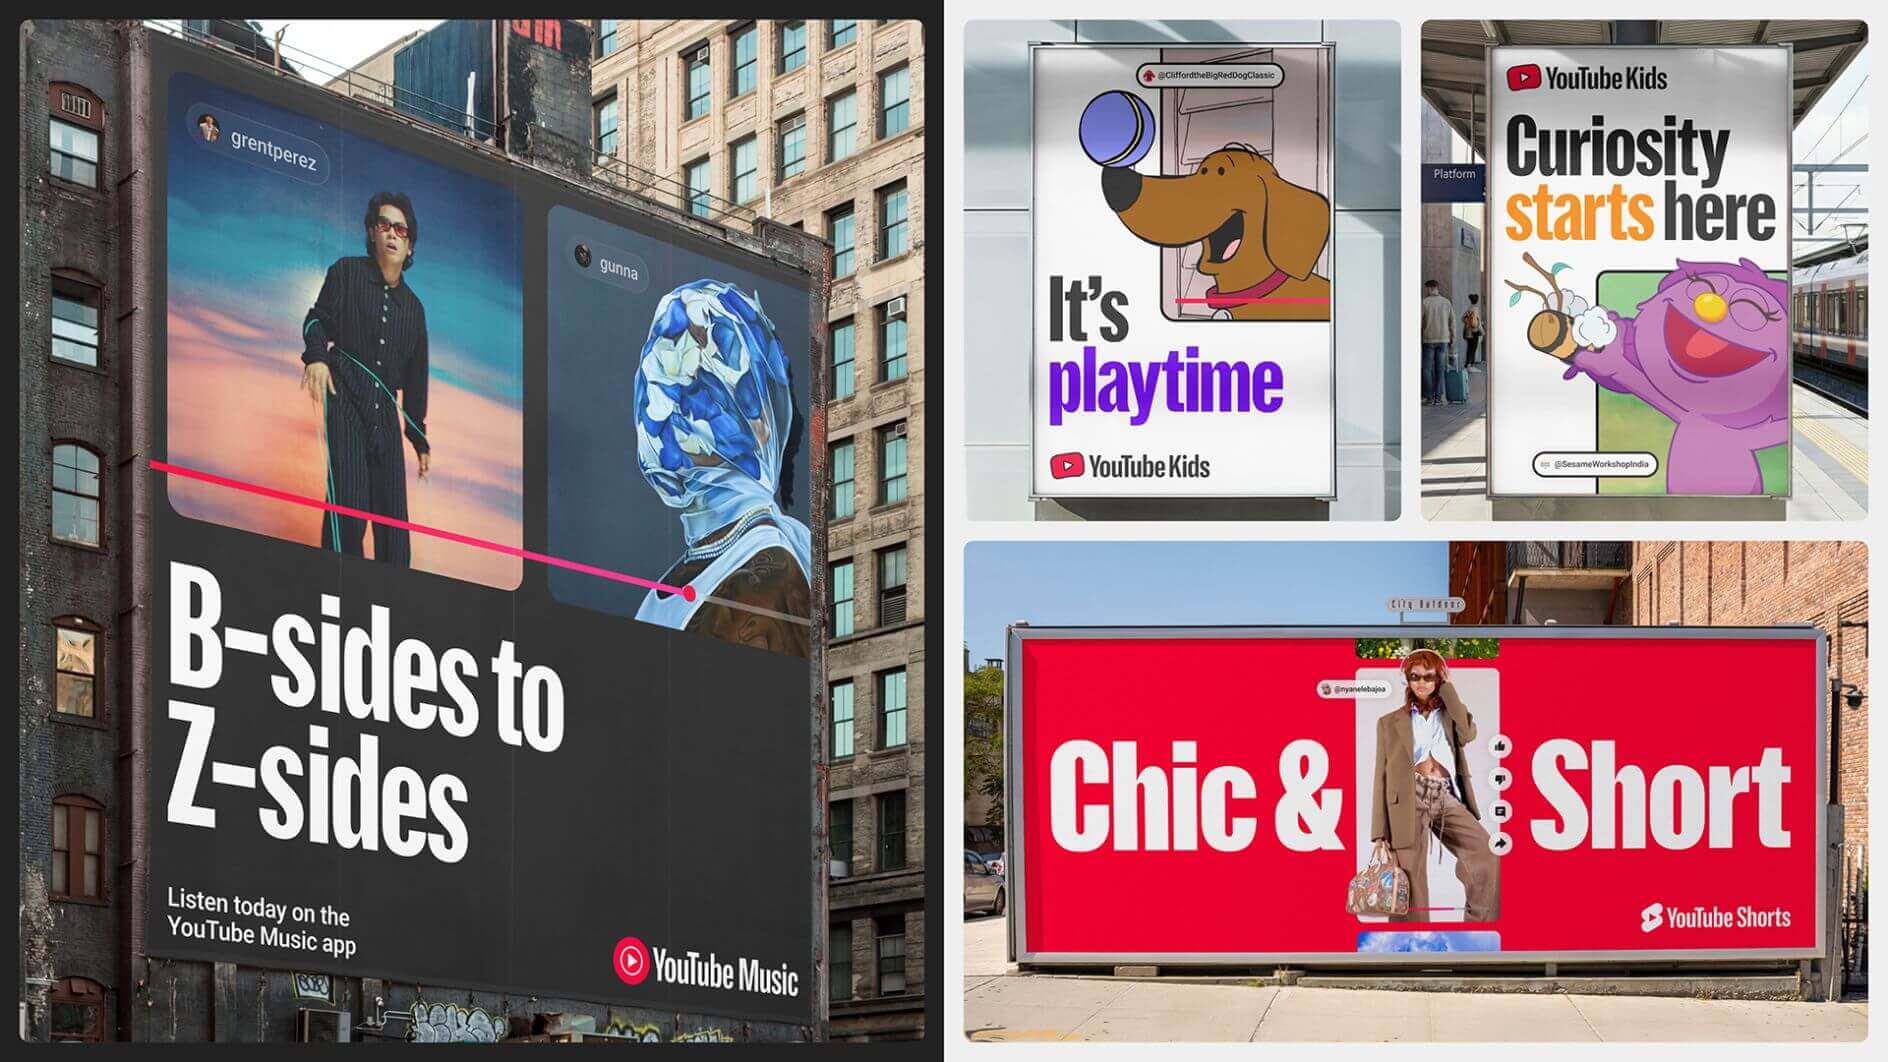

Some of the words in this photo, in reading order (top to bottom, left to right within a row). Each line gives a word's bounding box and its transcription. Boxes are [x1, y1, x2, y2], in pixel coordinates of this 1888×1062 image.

[1158, 71, 1275, 81] @CliffordtheBigRedDogClassic
[1546, 66, 1623, 90] YouTube
[1626, 66, 1668, 90] Kids
[231, 132, 317, 172] grentperez
[1506, 114, 1730, 188] Curiosity
[1433, 168, 1476, 179] Platform
[1505, 183, 1655, 241] starts
[1665, 180, 1776, 241] here
[599, 258, 639, 282] gunna
[1049, 346, 1284, 426] playtime
[1089, 454, 1166, 478] YouTube
[1169, 454, 1210, 478] Kids
[1554, 460, 1649, 470] @SesameWorkshopIndia
[492, 640, 565, 752] to
[1050, 739, 1257, 852] Chic
[1275, 739, 1345, 852] &
[1530, 738, 1791, 851] Short
[167, 887, 228, 914] Listen
[232, 895, 287, 924] today
[291, 906, 316, 923] on
[319, 905, 350, 928] the
[1667, 906, 1733, 929] YouTube
[1737, 906, 1791, 929] Shorts
[167, 915, 255, 944] YouTube
[260, 926, 318, 951] Music
[322, 937, 357, 960] app
[652, 946, 734, 990] YouTube
[738, 957, 799, 997] Music
